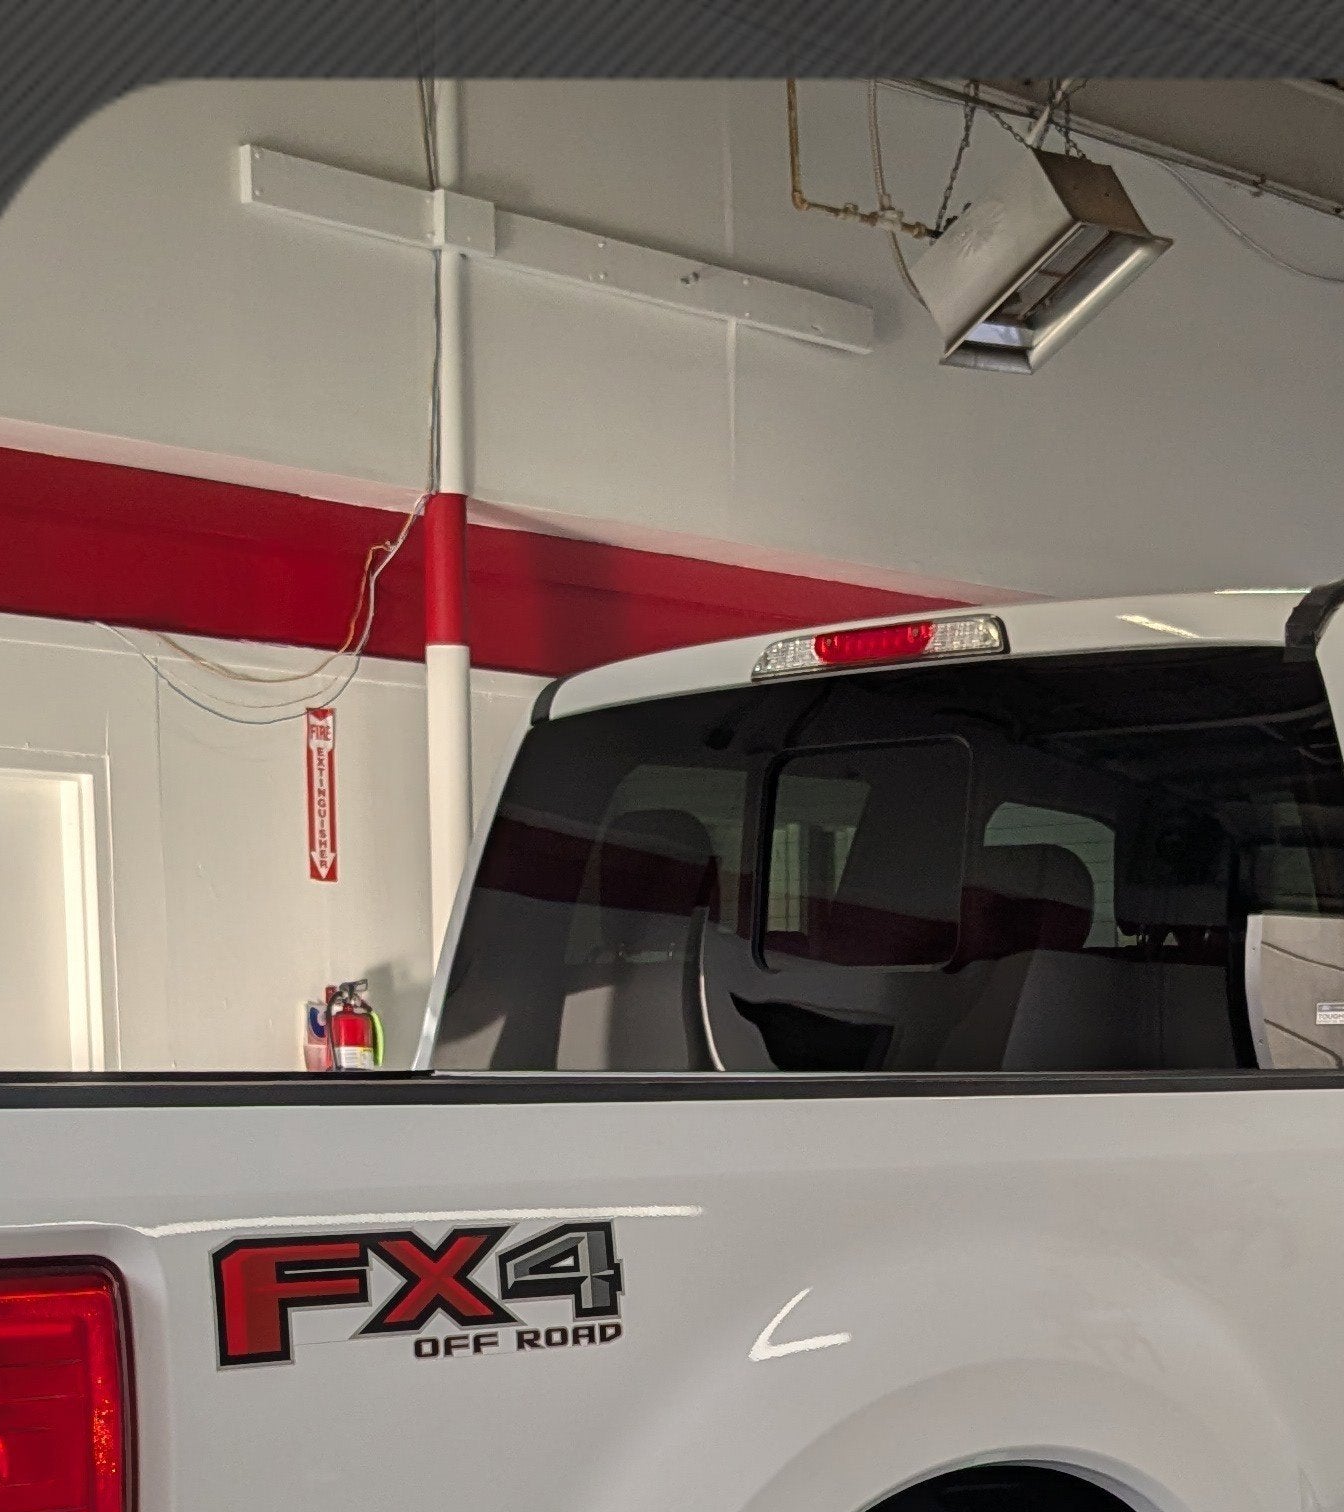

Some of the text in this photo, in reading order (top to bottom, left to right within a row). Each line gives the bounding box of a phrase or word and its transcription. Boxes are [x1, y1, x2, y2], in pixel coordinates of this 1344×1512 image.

[308, 724, 331, 741] FIRE
[317, 747, 327, 868] EXTINGUISHER
[210, 1217, 624, 1372] FX4
[413, 1322, 623, 1359] OFF ROAD
